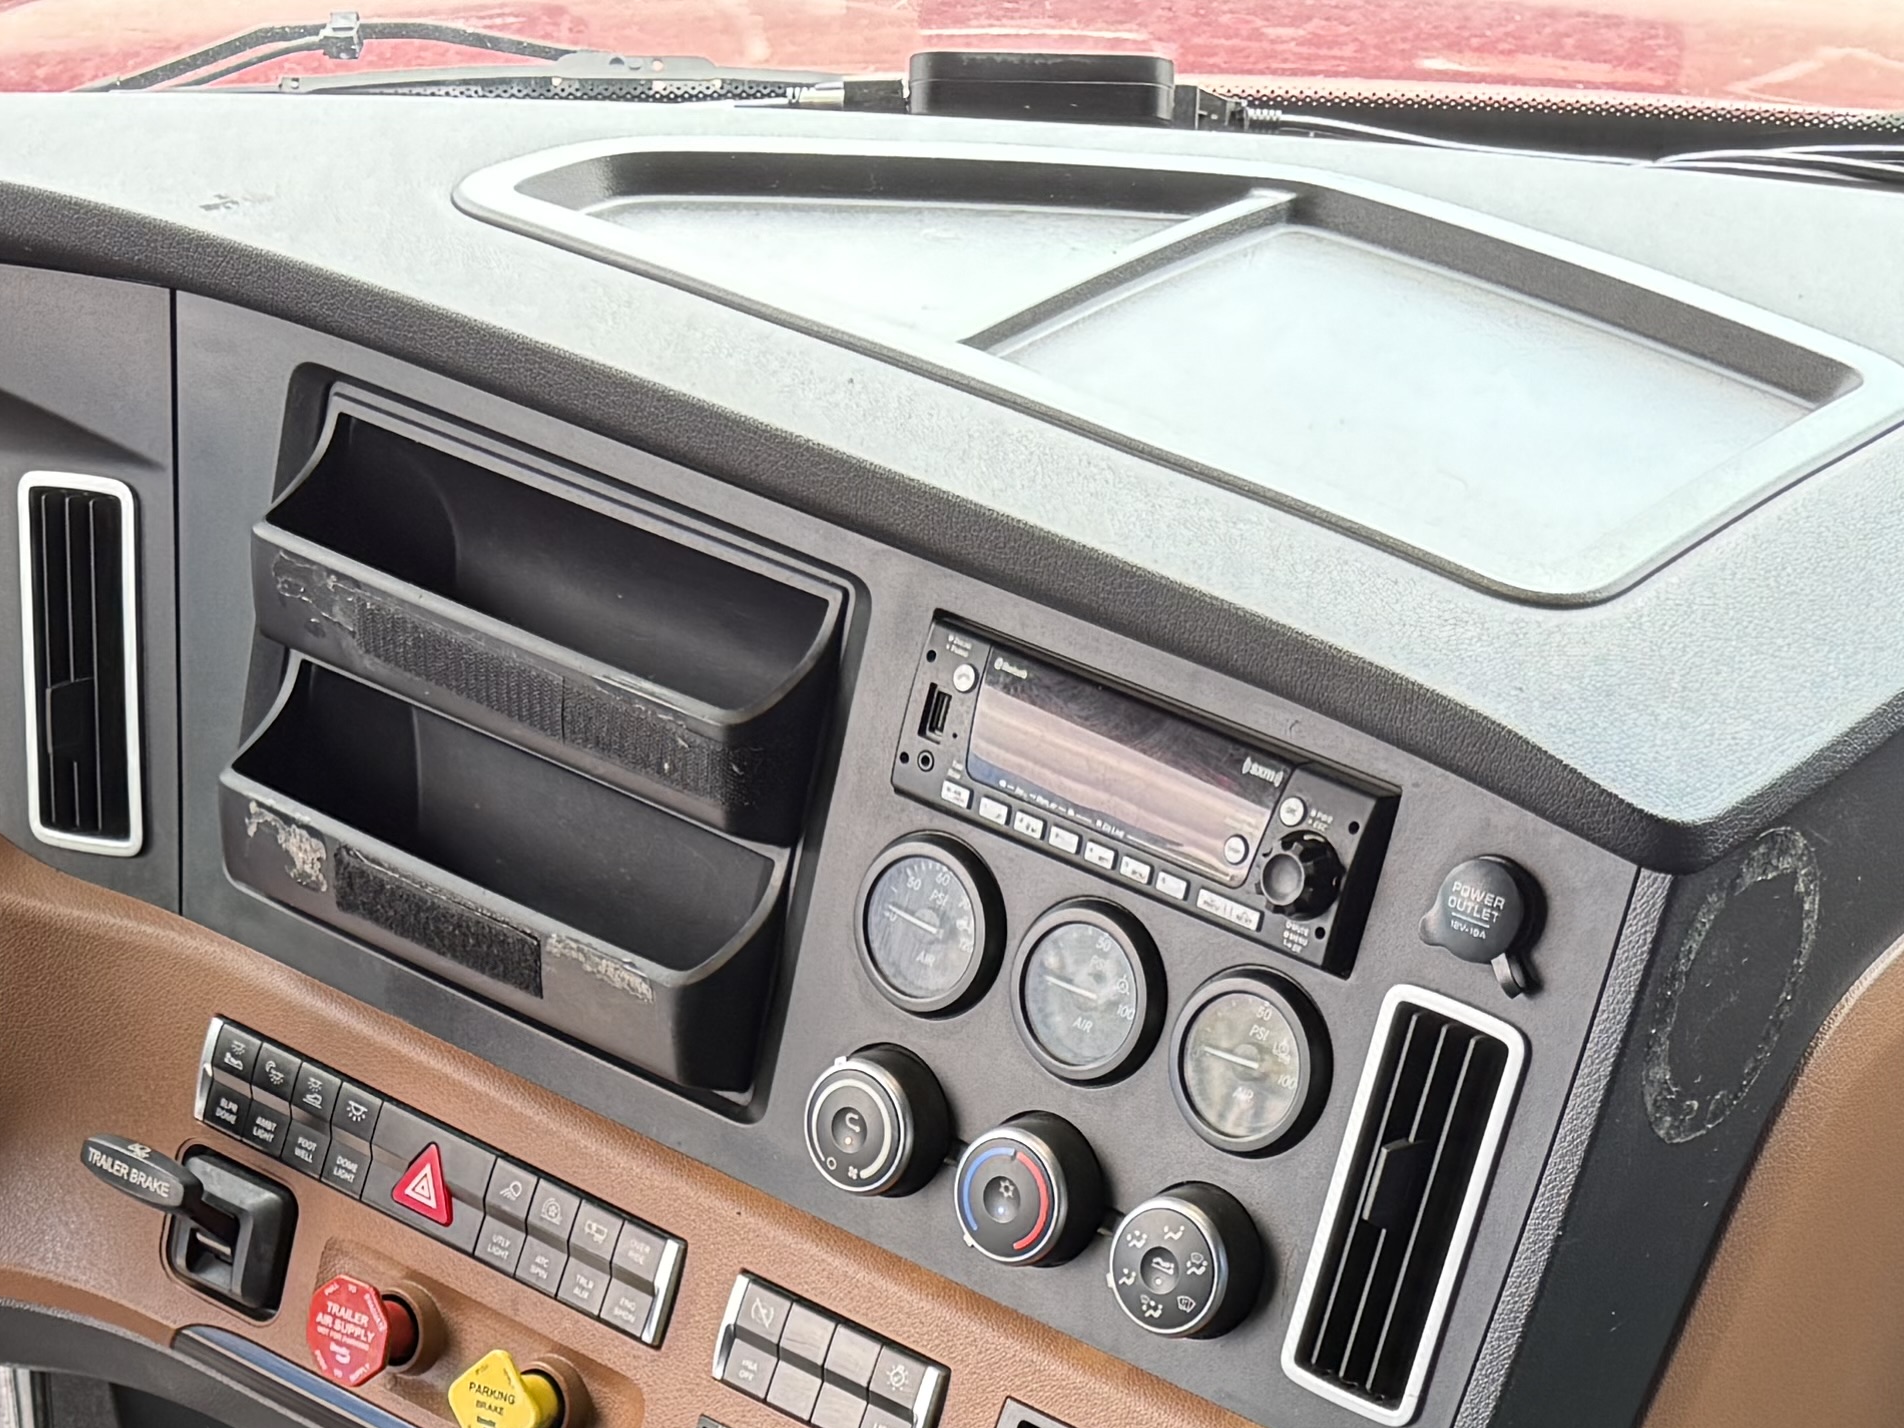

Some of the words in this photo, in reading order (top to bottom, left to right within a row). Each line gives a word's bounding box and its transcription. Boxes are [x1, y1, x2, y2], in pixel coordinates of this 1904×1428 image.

[935, 872, 951, 886] 60
[929, 888, 948, 907] PSI
[1452, 881, 1506, 910] POWER
[1447, 895, 1499, 924] OUTLET
[1095, 936, 1112, 952] 50
[915, 949, 936, 968] AIR
[1117, 1003, 1136, 1021] 100
[1255, 1005, 1273, 1021] 50
[1072, 1015, 1094, 1033] AIR
[1249, 1024, 1270, 1041] PSI
[1277, 1073, 1298, 1090] 100
[215, 1106, 238, 1125] DOME
[252, 1125, 275, 1143] LIGHT
[297, 1136, 318, 1153] FOOT
[294, 1144, 313, 1164] WELL
[87, 1146, 129, 1181] TRAILER
[129, 1166, 171, 1199] BRAKE
[336, 1154, 358, 1173] DOME
[333, 1164, 355, 1184] LIGHT
[487, 1243, 509, 1260] LIGHT
[529, 1265, 548, 1280] SPIN
[326, 1300, 370, 1328] TRAILER
[315, 1312, 333, 1328] AIR
[333, 1318, 376, 1344] SUPPLY
[468, 1381, 516, 1406] PARKING
[475, 1400, 504, 1416] BRAKE
